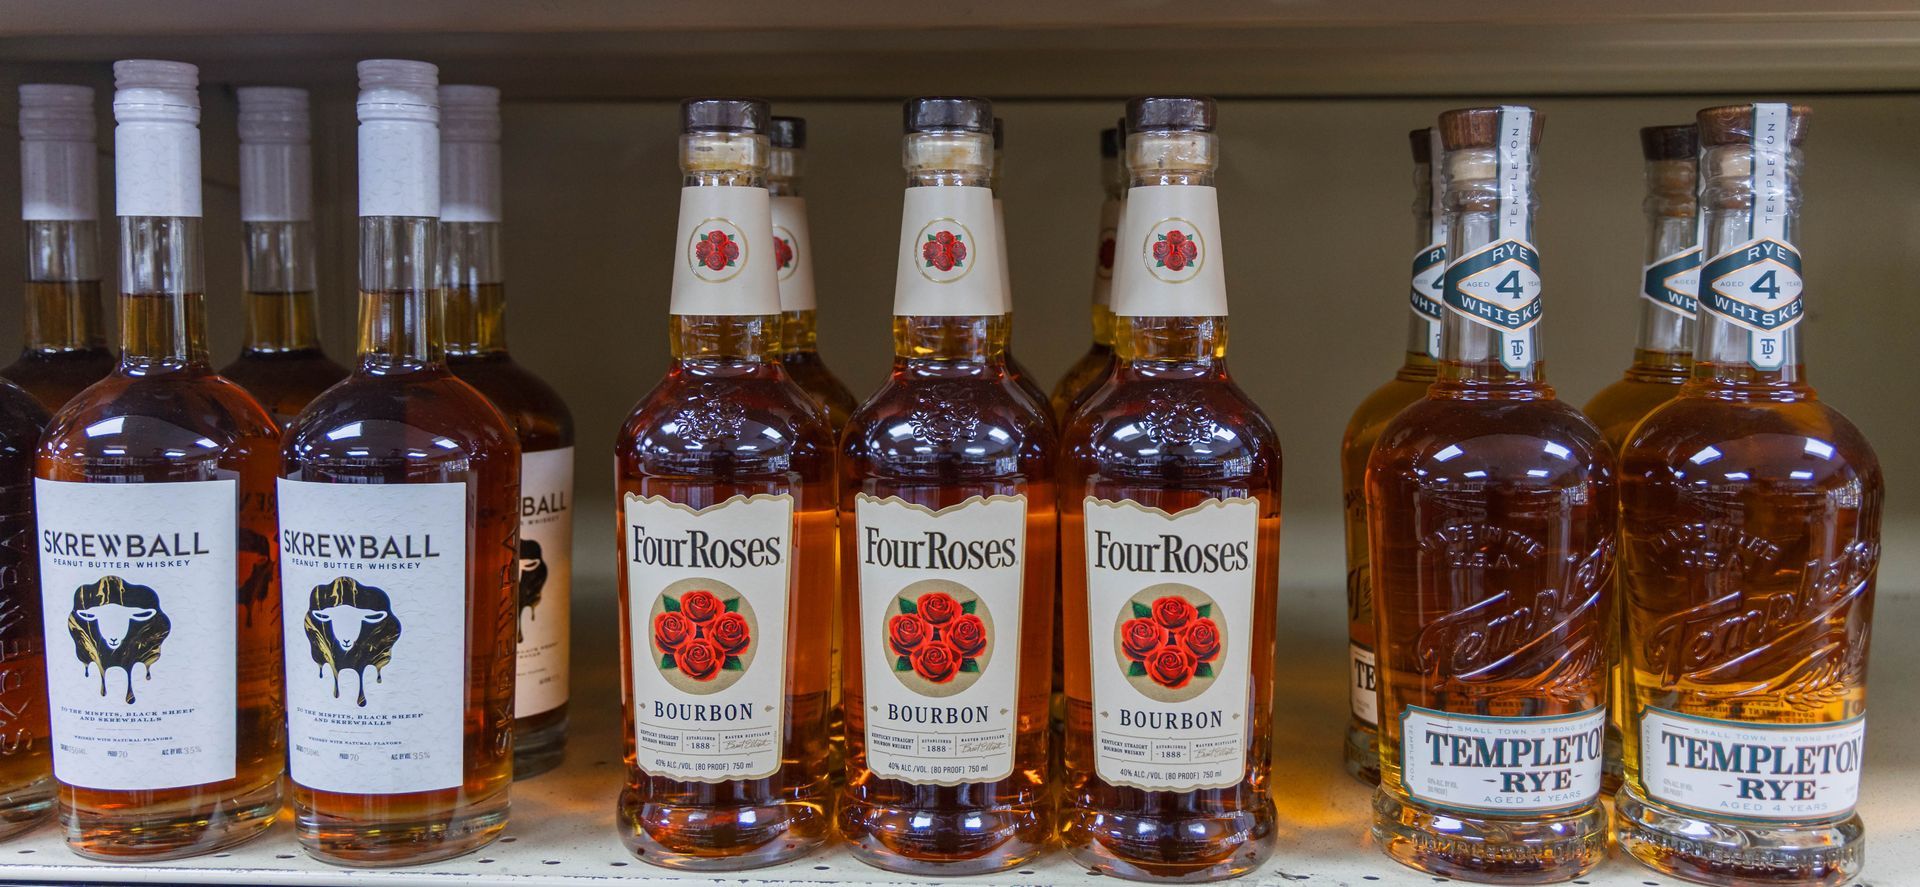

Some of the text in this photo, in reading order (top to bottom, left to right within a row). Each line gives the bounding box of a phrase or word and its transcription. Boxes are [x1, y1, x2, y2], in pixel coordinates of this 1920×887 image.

[1509, 127, 1520, 227] TEMPLETON
[1765, 122, 1775, 224] TEMPLETON
[1492, 244, 1528, 262] RYE
[1747, 246, 1786, 262] RYE
[1495, 270, 1523, 299] 4
[1750, 270, 1780, 300] 4
[1461, 294, 1542, 325] WHISKE
[522, 491, 567, 517] BALL
[44, 529, 210, 559] SKREWBALL
[284, 528, 440, 560] SKREWBALL
[53, 558, 191, 569] PEANUT BUTTER WHISKEY
[292, 558, 421, 570] PEANUT BUTTER WHISKEY
[319, 712, 354, 720] MISFITS,
[654, 700, 753, 722] BOURBON
[888, 703, 989, 724] BOURBON
[1120, 709, 1222, 729] BOURBON
[640, 729, 679, 741] KENTUCKY STRAIGHT
[871, 732, 914, 744] KENTUCKY STRAIGHT
[1456, 725, 1493, 734] SMALL
[1540, 725, 1576, 734] STRONG
[1694, 728, 1729, 739] SMALL
[658, 739, 677, 747] WHISKEY
[1101, 739, 1148, 750] KENTUCKY STRAIGHT
[1662, 730, 1862, 775] TEMPLETON
[732, 762, 744, 770] 750
[745, 761, 754, 770] ml
[968, 764, 980, 773] 750
[980, 763, 989, 772] ml
[1202, 771, 1214, 779] 750
[1215, 770, 1222, 778] ml
[1500, 768, 1572, 793] RYE
[1483, 795, 1524, 804] AGED
[1548, 790, 1582, 801] YEARS
[1736, 777, 1816, 801] RYE
[1720, 801, 1828, 812] AGED 4 YEARS
